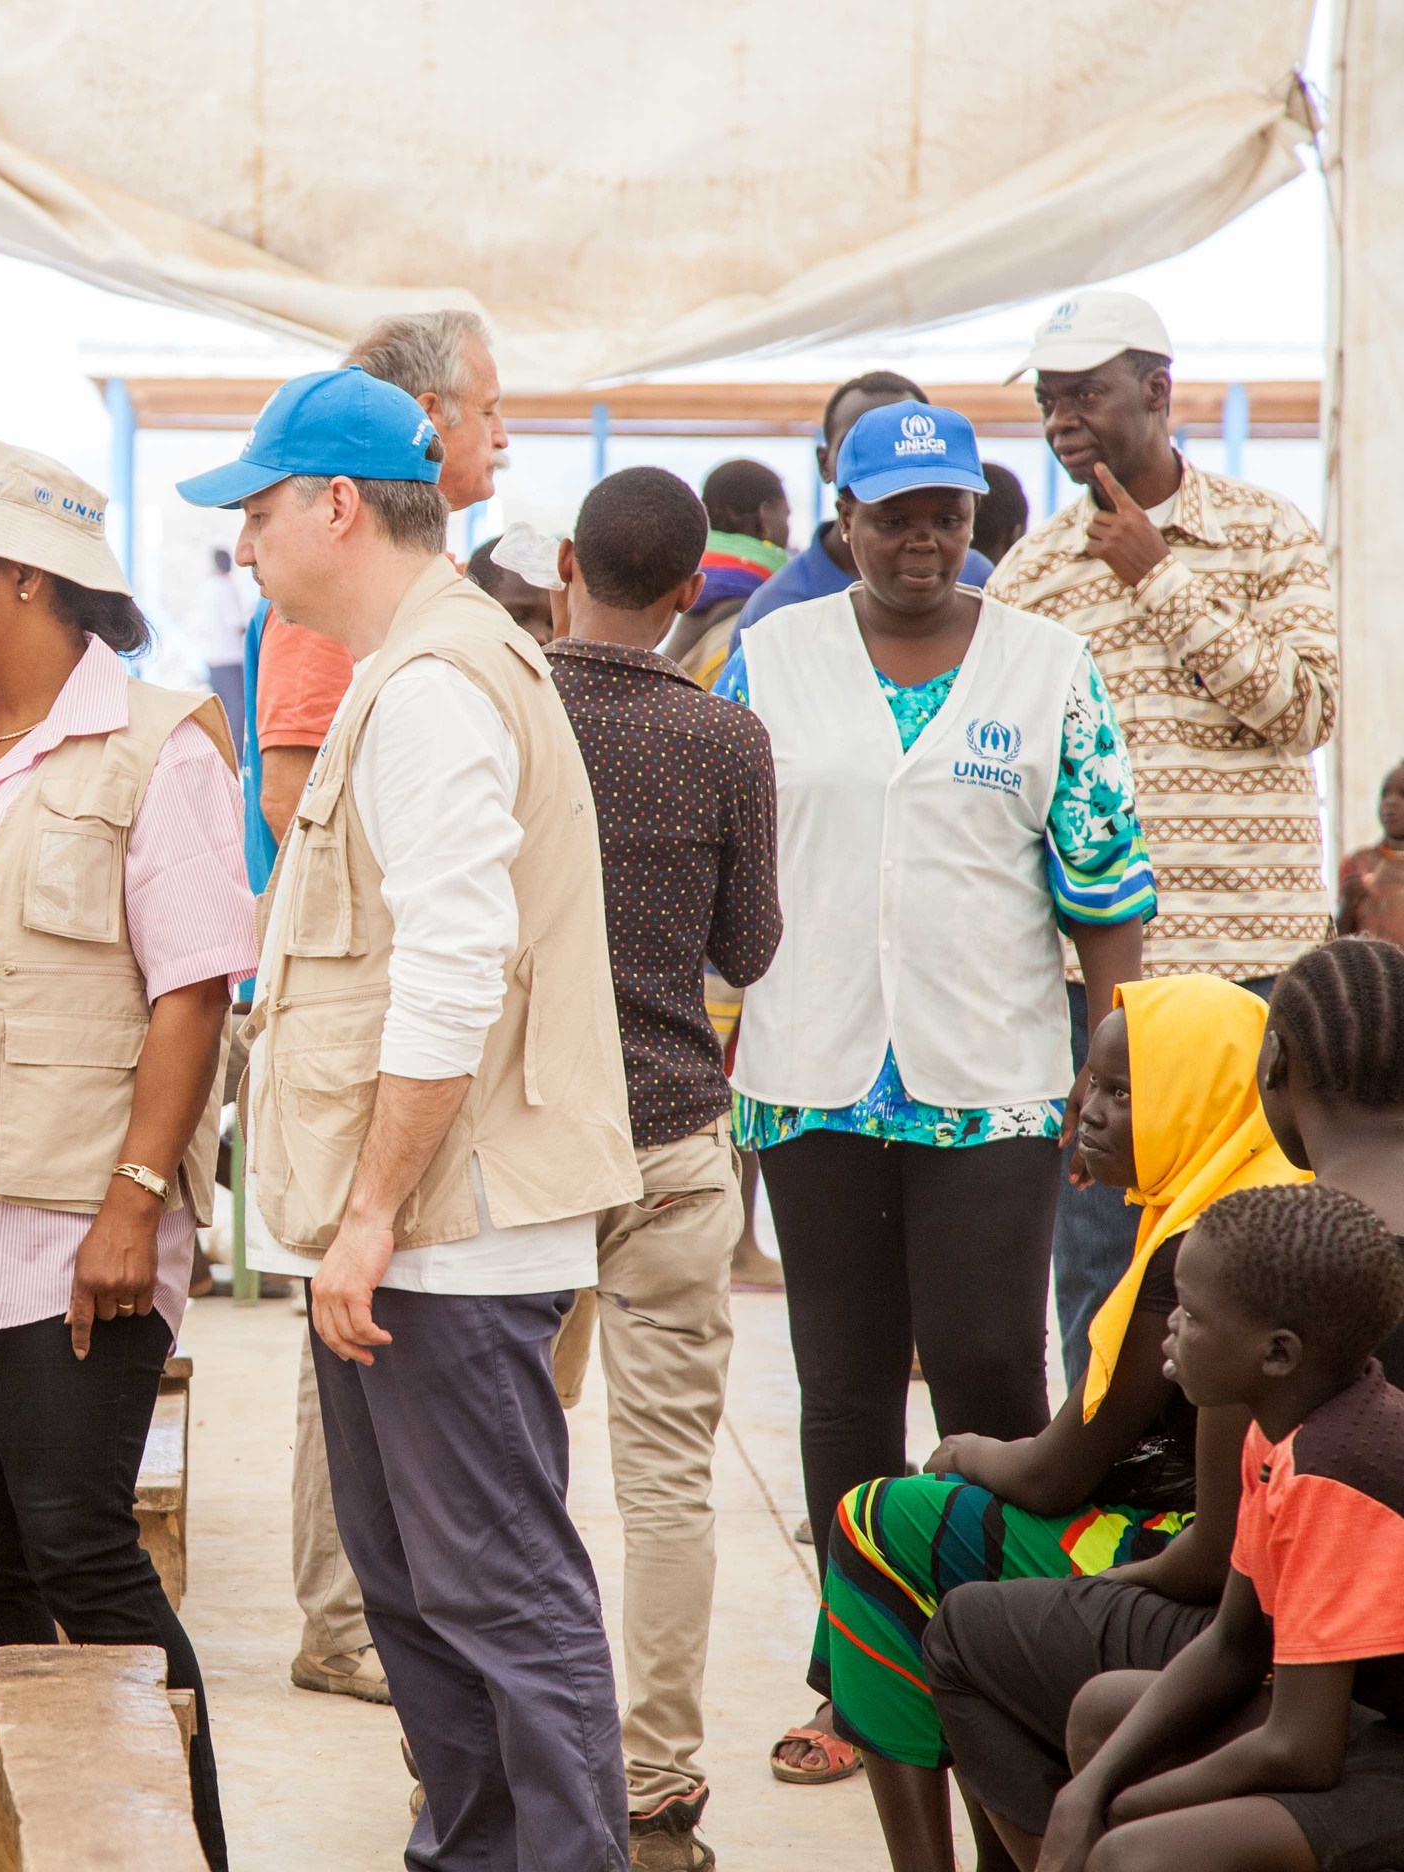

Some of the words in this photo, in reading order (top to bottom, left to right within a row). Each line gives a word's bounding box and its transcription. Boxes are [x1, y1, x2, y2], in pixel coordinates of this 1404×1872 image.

[894, 437, 947, 451] UNHCR
[62, 497, 104, 522] UNHC
[953, 761, 1022, 790] UNHCR
[979, 781, 1002, 790] Refugee
[1002, 786, 1019, 798] Agency
